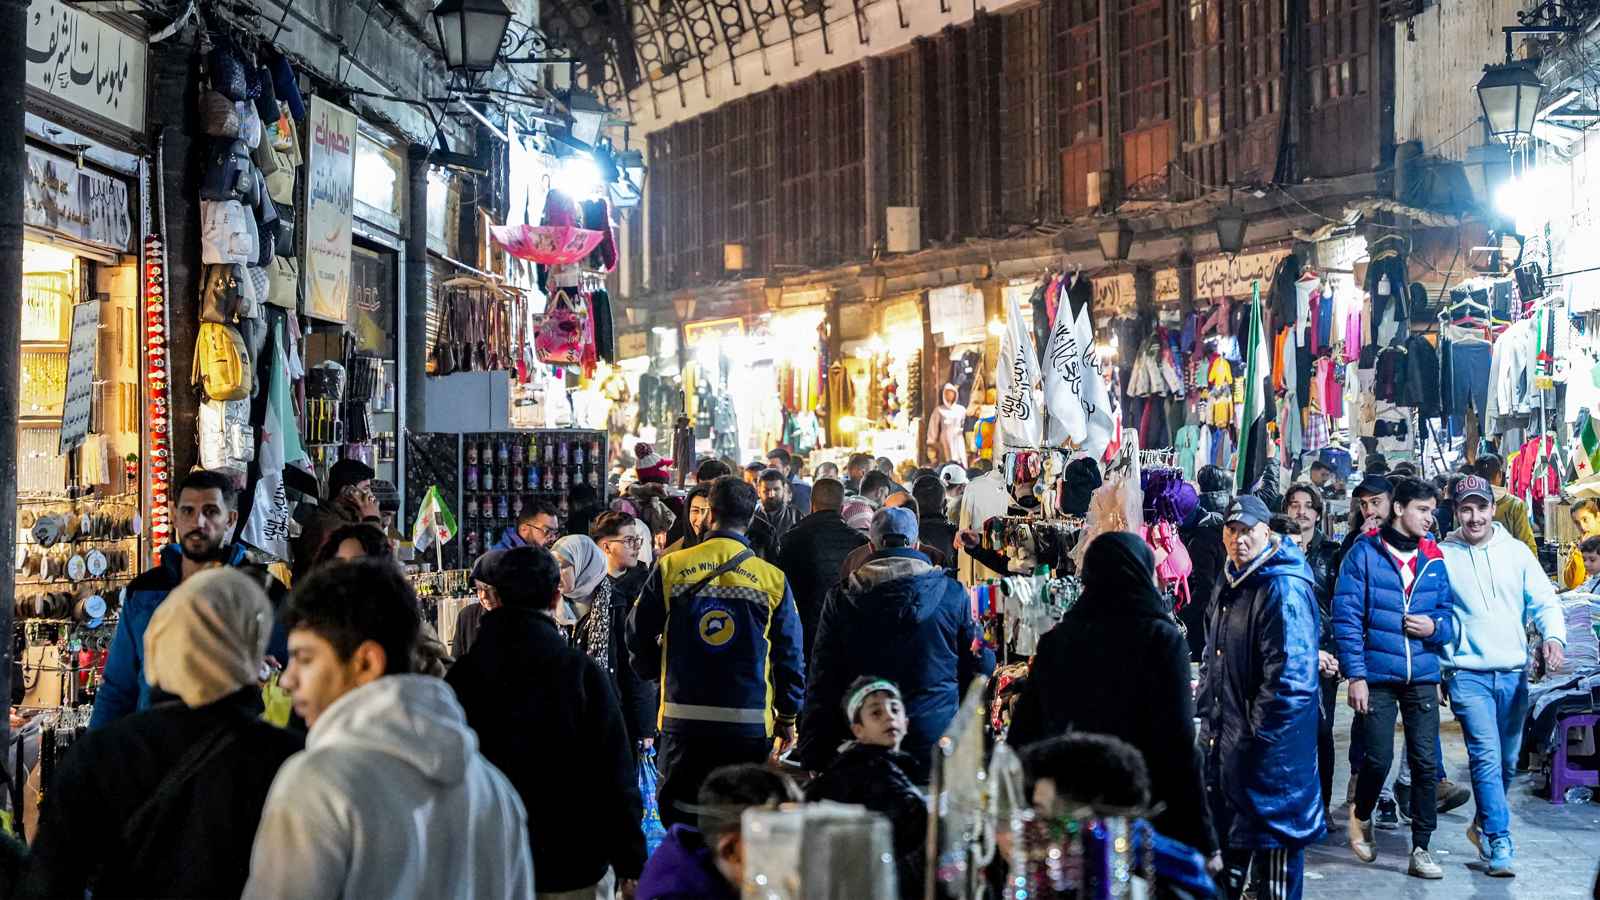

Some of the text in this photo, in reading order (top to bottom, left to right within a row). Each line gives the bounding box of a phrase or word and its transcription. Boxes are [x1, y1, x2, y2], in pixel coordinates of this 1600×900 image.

[70, 29, 128, 110] ملبوسات
[679, 566, 697, 577] The
[735, 566, 758, 584] lmets
